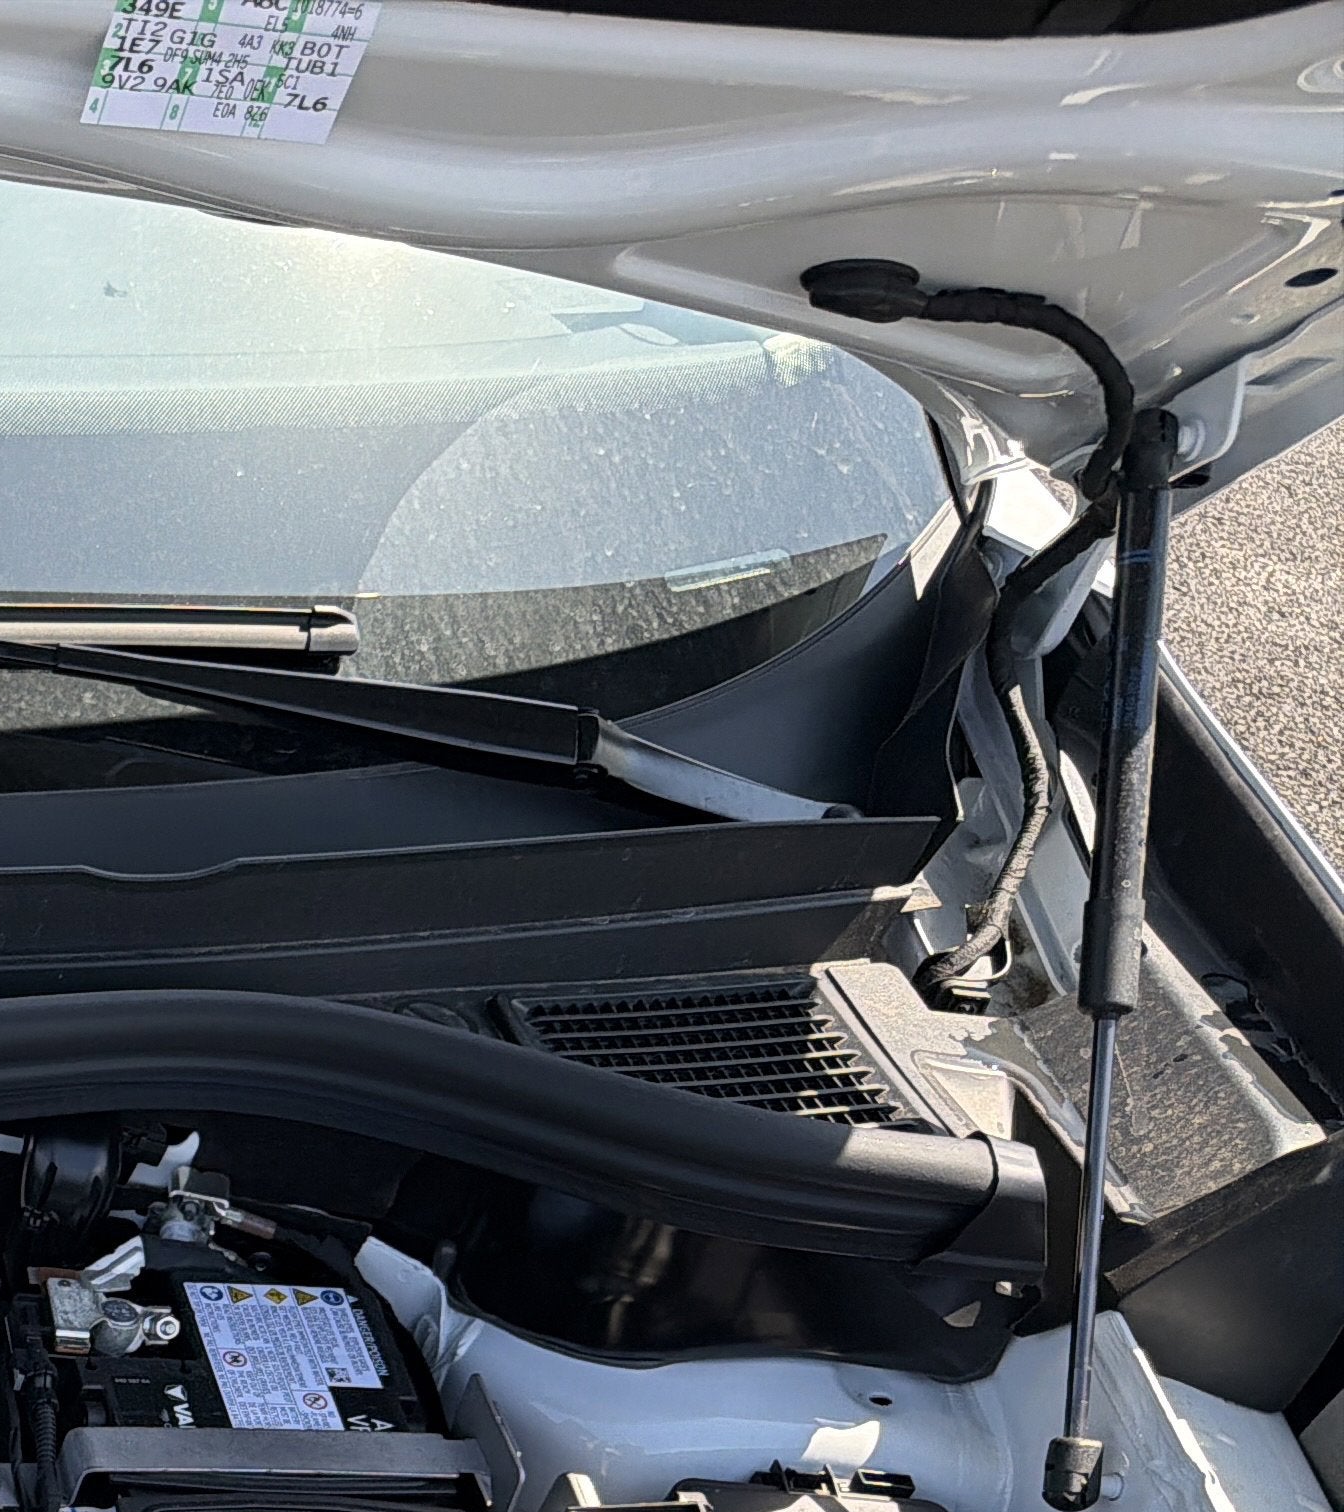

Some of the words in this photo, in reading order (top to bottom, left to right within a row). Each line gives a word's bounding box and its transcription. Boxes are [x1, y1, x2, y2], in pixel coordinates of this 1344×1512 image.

[109, 55, 155, 74] 7L6
[101, 73, 146, 92] 9V2
[153, 77, 197, 95] 9AK
[169, 104, 180, 120] 8
[284, 93, 329, 112] 7L6
[353, 1307, 390, 1377] DANGER/POISON
